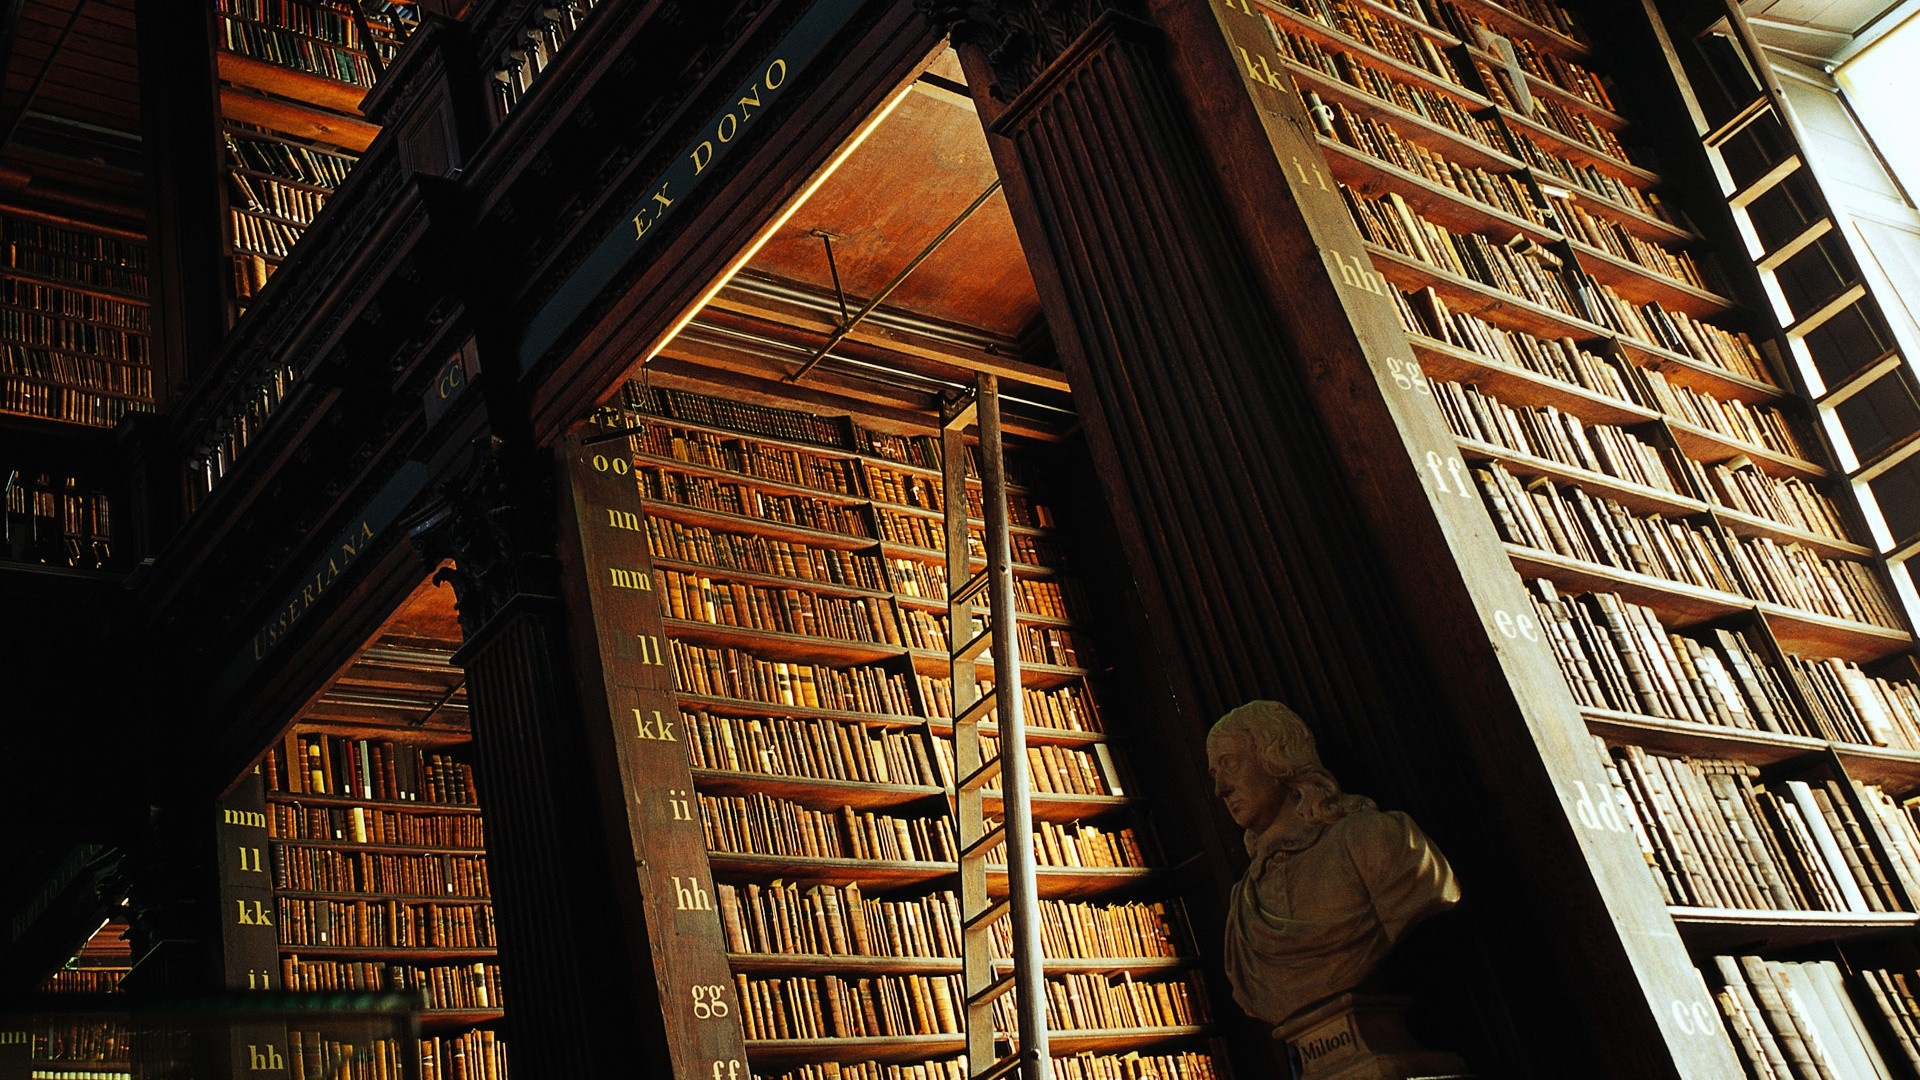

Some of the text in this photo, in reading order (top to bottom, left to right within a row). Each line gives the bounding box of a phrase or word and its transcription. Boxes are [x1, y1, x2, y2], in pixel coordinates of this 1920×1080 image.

[1237, 46, 1288, 93] kk
[632, 58, 787, 241] EX DONO
[1293, 157, 1330, 192] ii
[1329, 249, 1384, 296] hh
[440, 365, 460, 399] CC
[1386, 356, 1430, 395] gg
[592, 454, 628, 475] oo
[1426, 450, 1472, 499] ff
[607, 508, 641, 531] nn
[253, 520, 376, 661] USSERIANA
[609, 567, 652, 591] mm
[1493, 609, 1538, 643] ee
[632, 708, 677, 742] kk
[224, 808, 266, 828] mm
[669, 789, 693, 821] ii
[1573, 780, 1626, 833] dd
[671, 876, 712, 911] hh
[237, 900, 273, 926] kk
[691, 985, 728, 1019] gg
[1671, 999, 1715, 1036] cc
[248, 1044, 284, 1070] hh
[1300, 1031, 1350, 1064] Milton
[712, 1059, 741, 1080] ff
